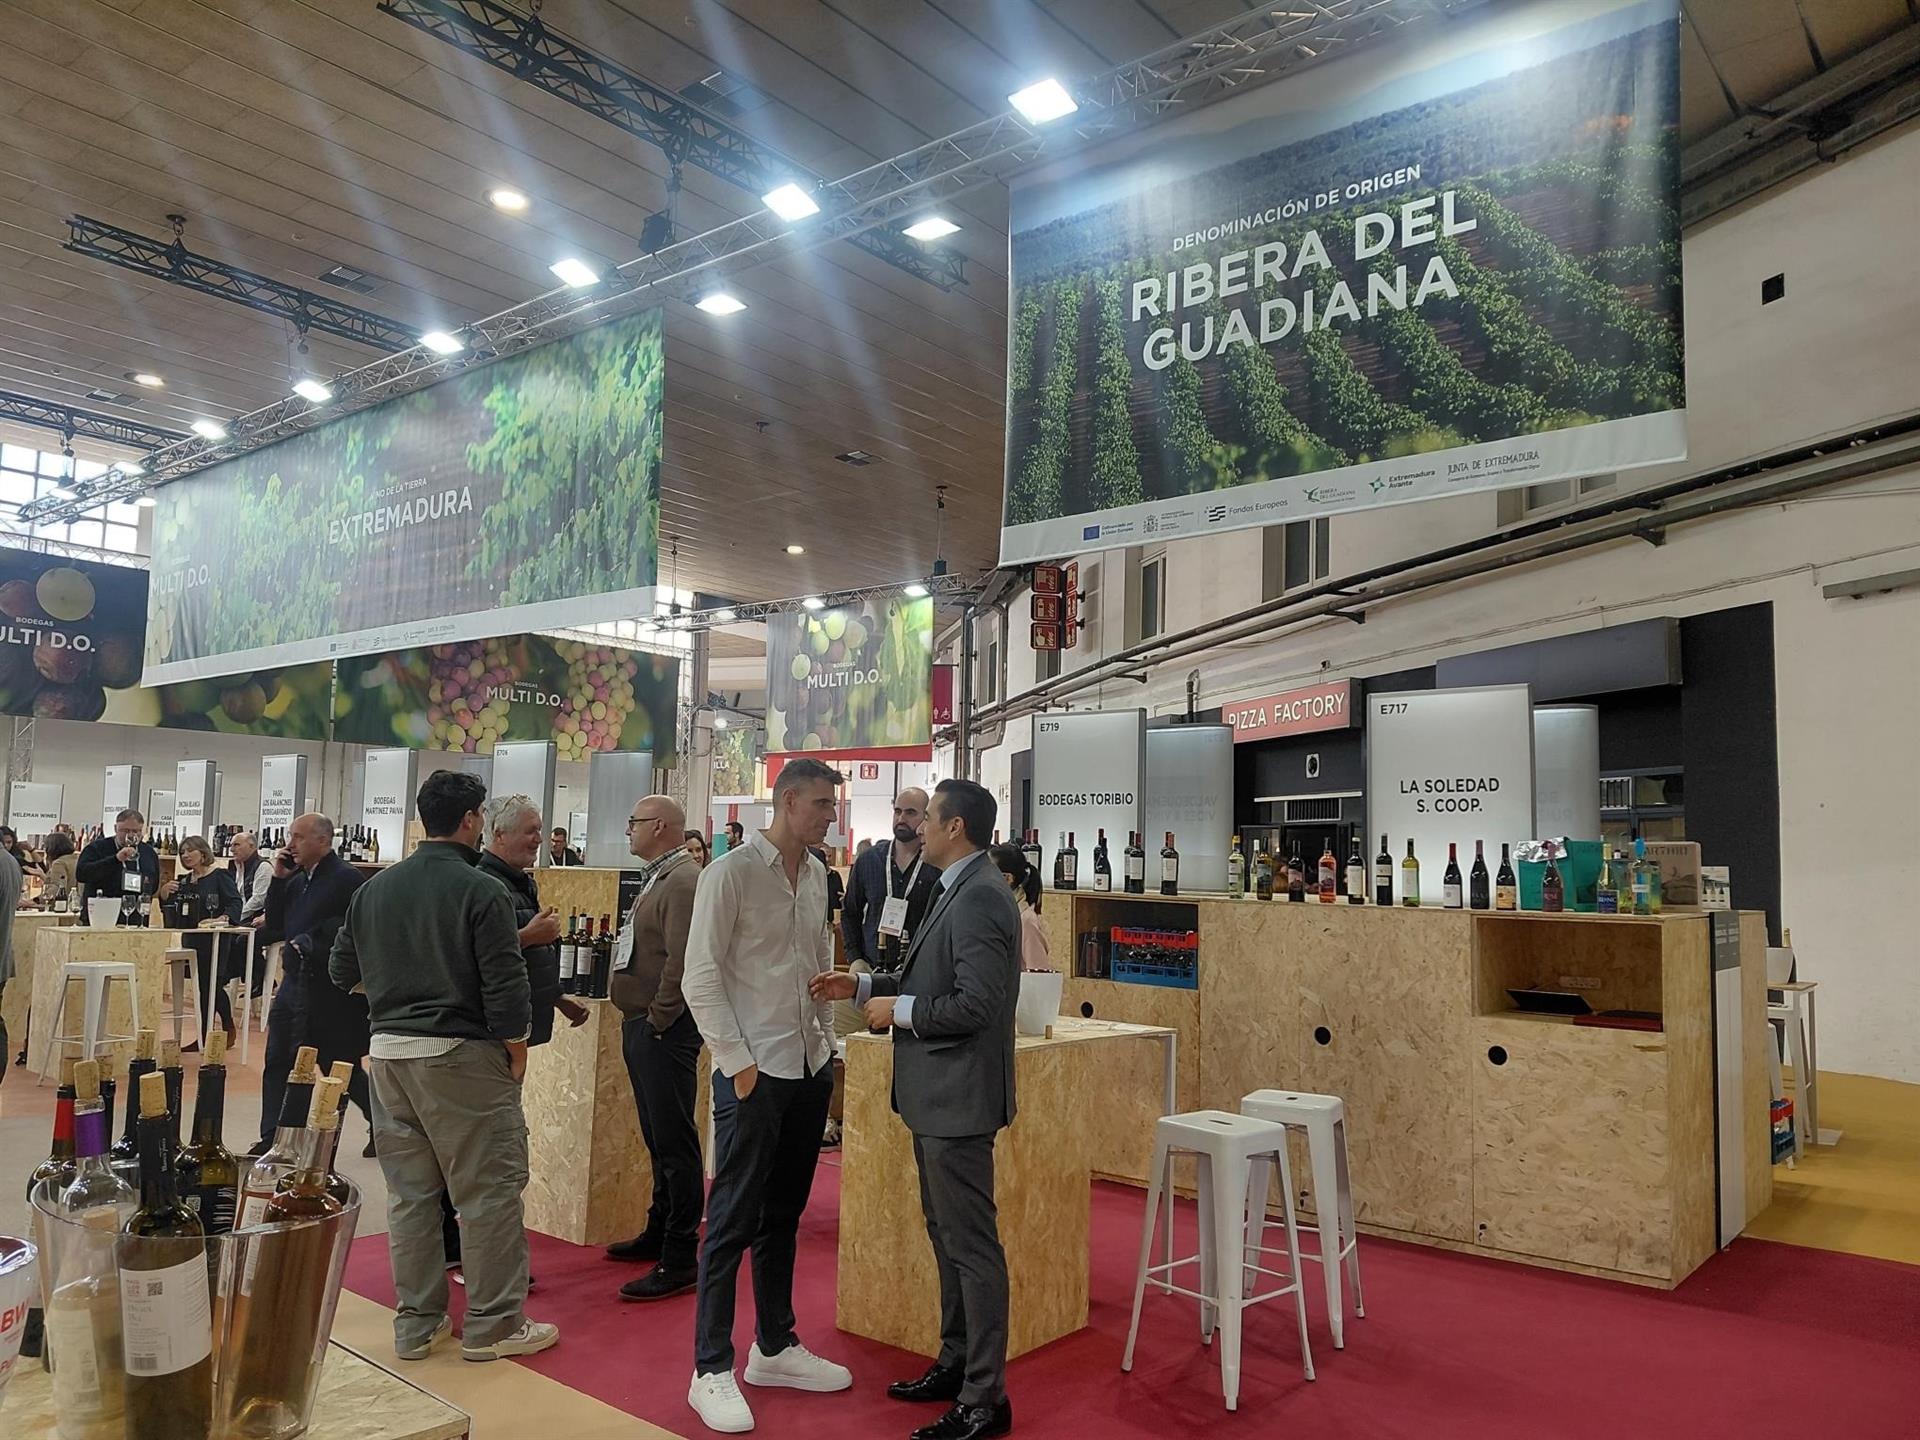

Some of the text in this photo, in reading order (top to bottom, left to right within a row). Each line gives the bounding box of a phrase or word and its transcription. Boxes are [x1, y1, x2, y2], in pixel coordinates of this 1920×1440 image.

[1173, 164, 1422, 252] DENOMINACIÓN DE ORIGEN
[1131, 190, 1478, 322] RIBERA DEL
[1142, 255, 1460, 371] GUADIANA
[1447, 450, 1541, 476] JUNTA DE EXTREMADURA
[1388, 468, 1436, 482] Extremadura
[1388, 479, 1413, 489] Avante
[386, 486, 395, 496] DE
[395, 482, 404, 493] LA
[404, 477, 427, 491] TIERRA
[329, 485, 473, 545] EXTREMADURA
[1229, 500, 1289, 515] Fondos Europeos
[150, 564, 211, 598] MULTI D.O.
[15, 616, 55, 628] BODEGAS
[50, 631, 96, 653] D.O.
[807, 668, 883, 690] MULTI D.O.
[486, 686, 564, 707] MULTI D.O.
[1228, 692, 1345, 730] PIZZA FACTORY
[1380, 703, 1408, 715] E717
[1040, 722, 1060, 732] E719
[1400, 777, 1500, 795] LA SOLEDAD
[373, 796, 396, 805] BODEGAS
[1038, 792, 1134, 806] BODEGAS TORIBIO
[1416, 797, 1483, 814] S. COOP.
[389, 806, 404, 815] PAIVA
